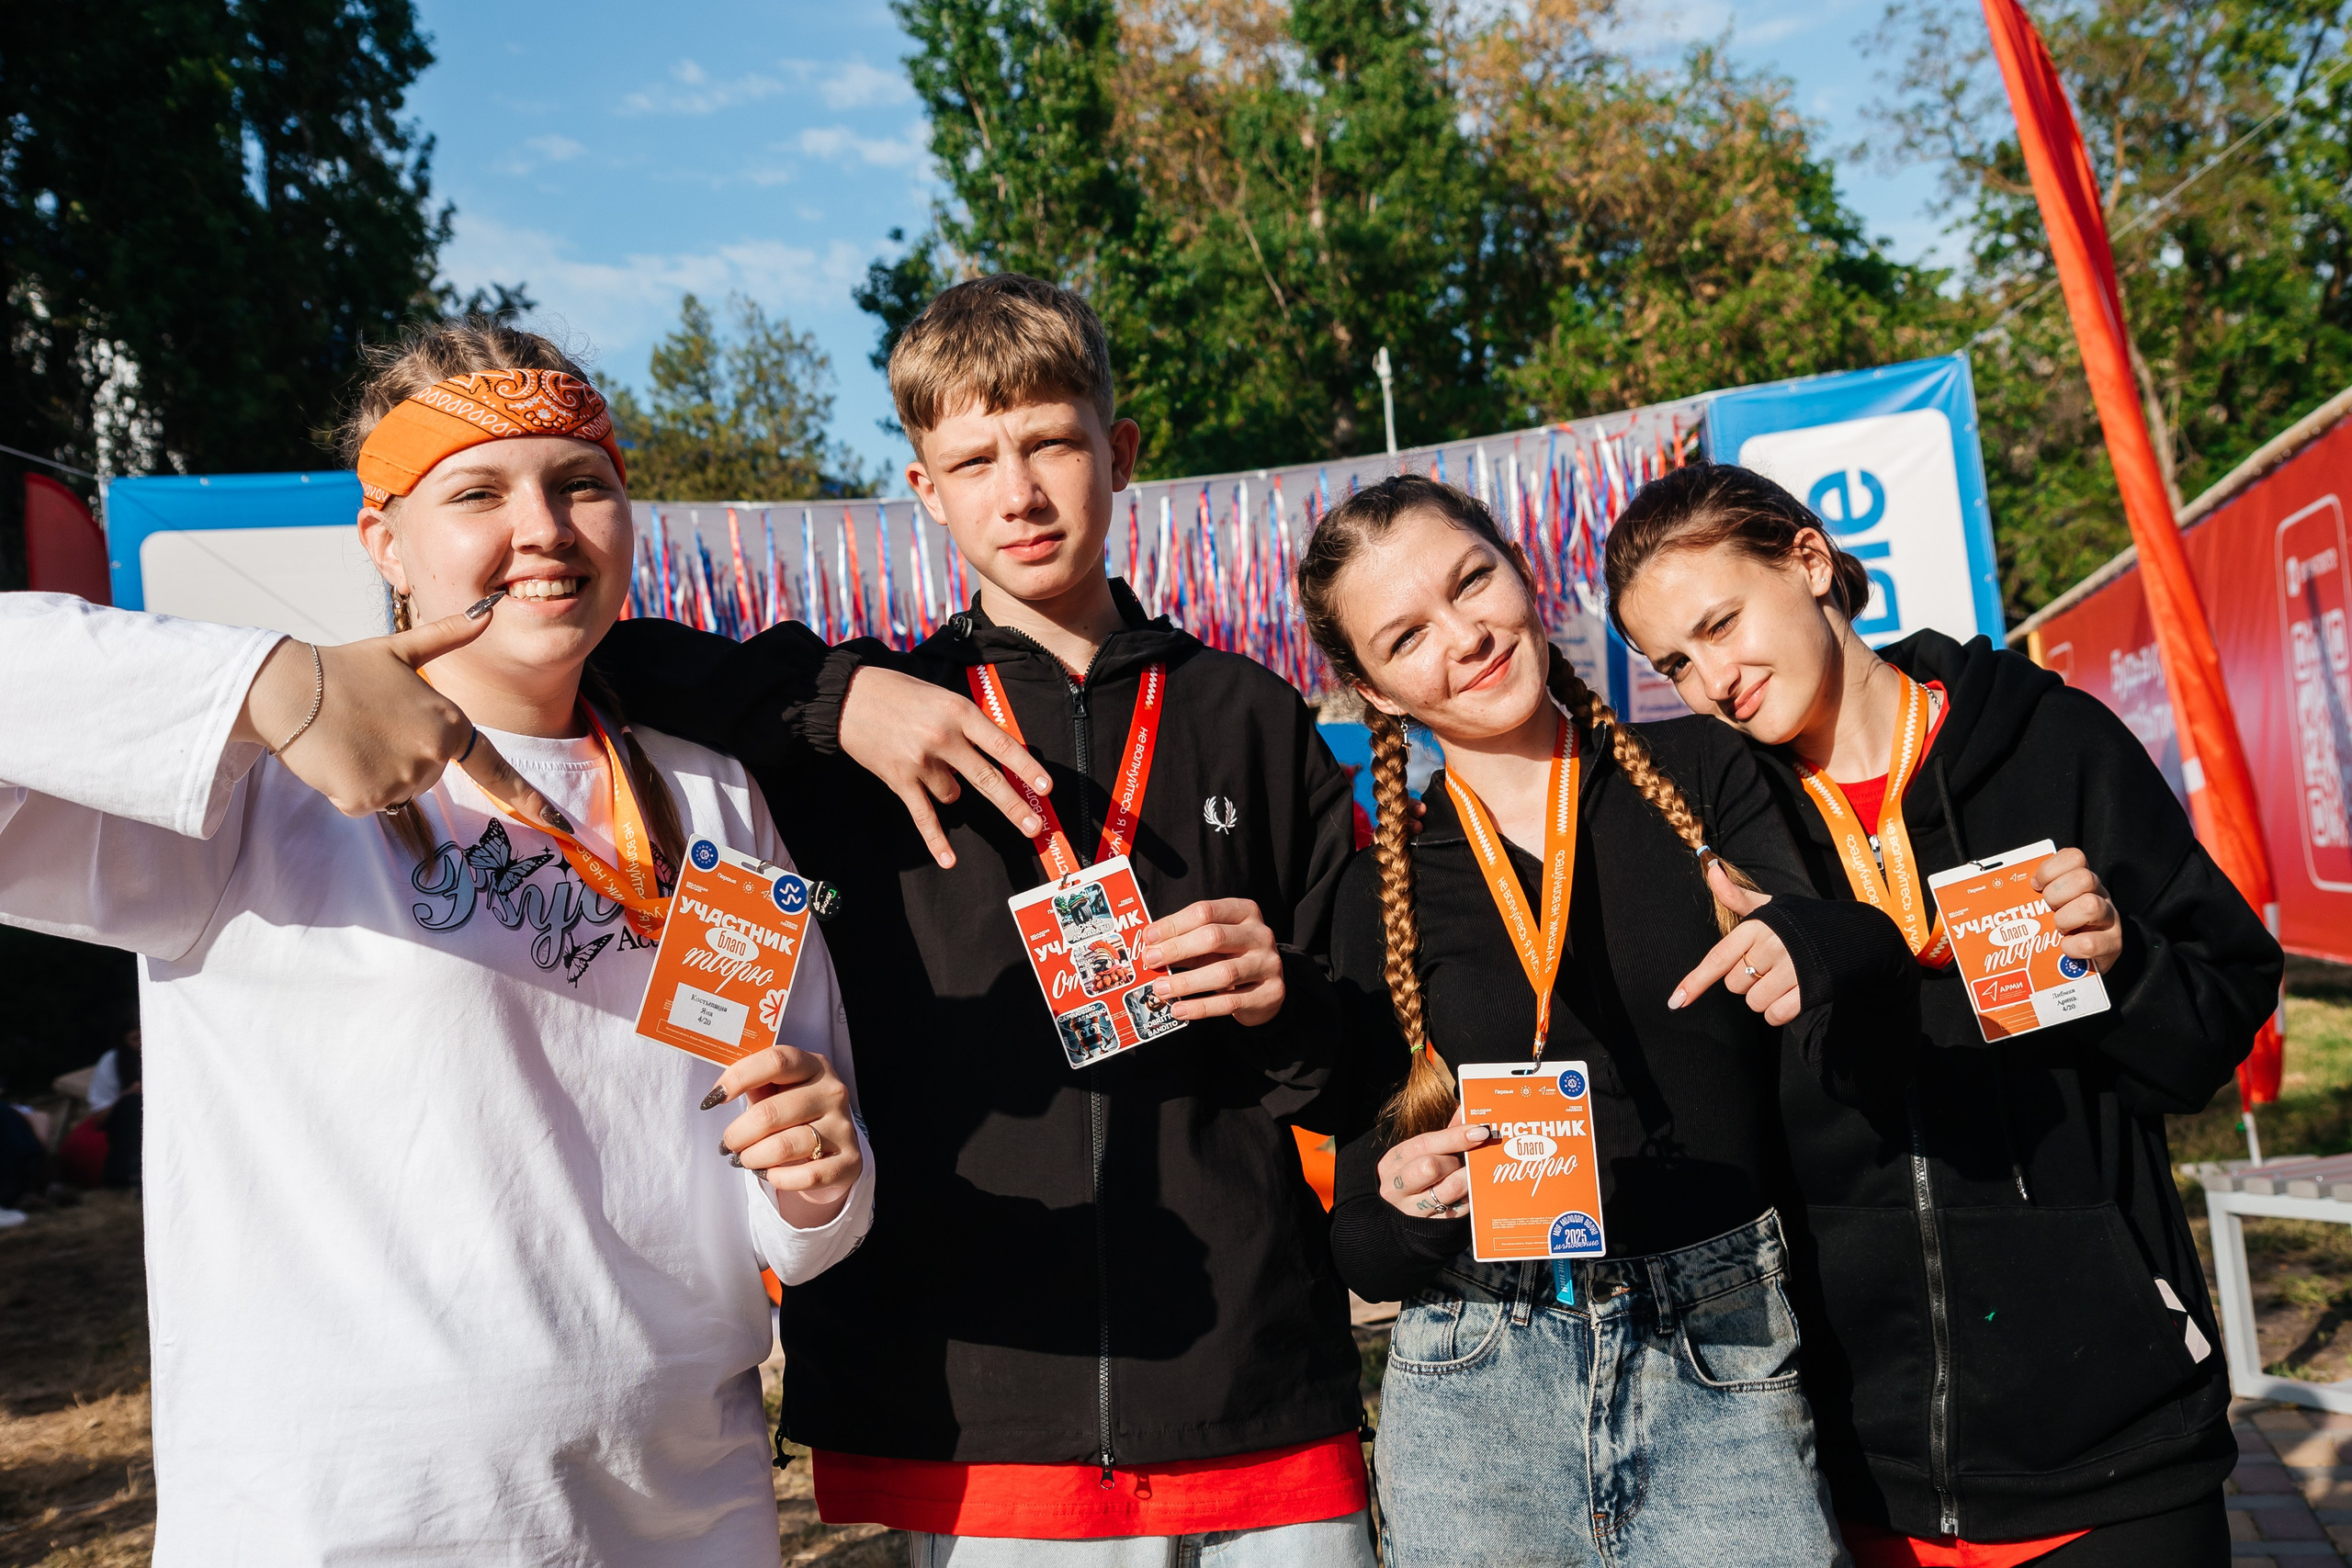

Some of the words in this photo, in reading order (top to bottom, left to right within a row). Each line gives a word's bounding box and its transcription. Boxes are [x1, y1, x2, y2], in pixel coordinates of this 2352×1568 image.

[1120, 746, 1146, 815] волнуйтесь
[1889, 836, 1912, 911] волнуйтесь
[679, 896, 796, 956] УЧАСТНИК
[1503, 889, 1527, 942] волнуйтесь
[1951, 897, 2053, 940] УЧАСТНИ
[1999, 923, 2029, 942] благо
[717, 931, 747, 957] благо
[682, 947, 775, 994] творю
[1999, 981, 2024, 993] АРМИ
[697, 1015, 712, 1026] 4/20
[1148, 1020, 1179, 1038] BANDITO
[1516, 1137, 1544, 1156] благо
[1492, 1155, 1578, 1198] творю
[1565, 1228, 1587, 1245] 2025
